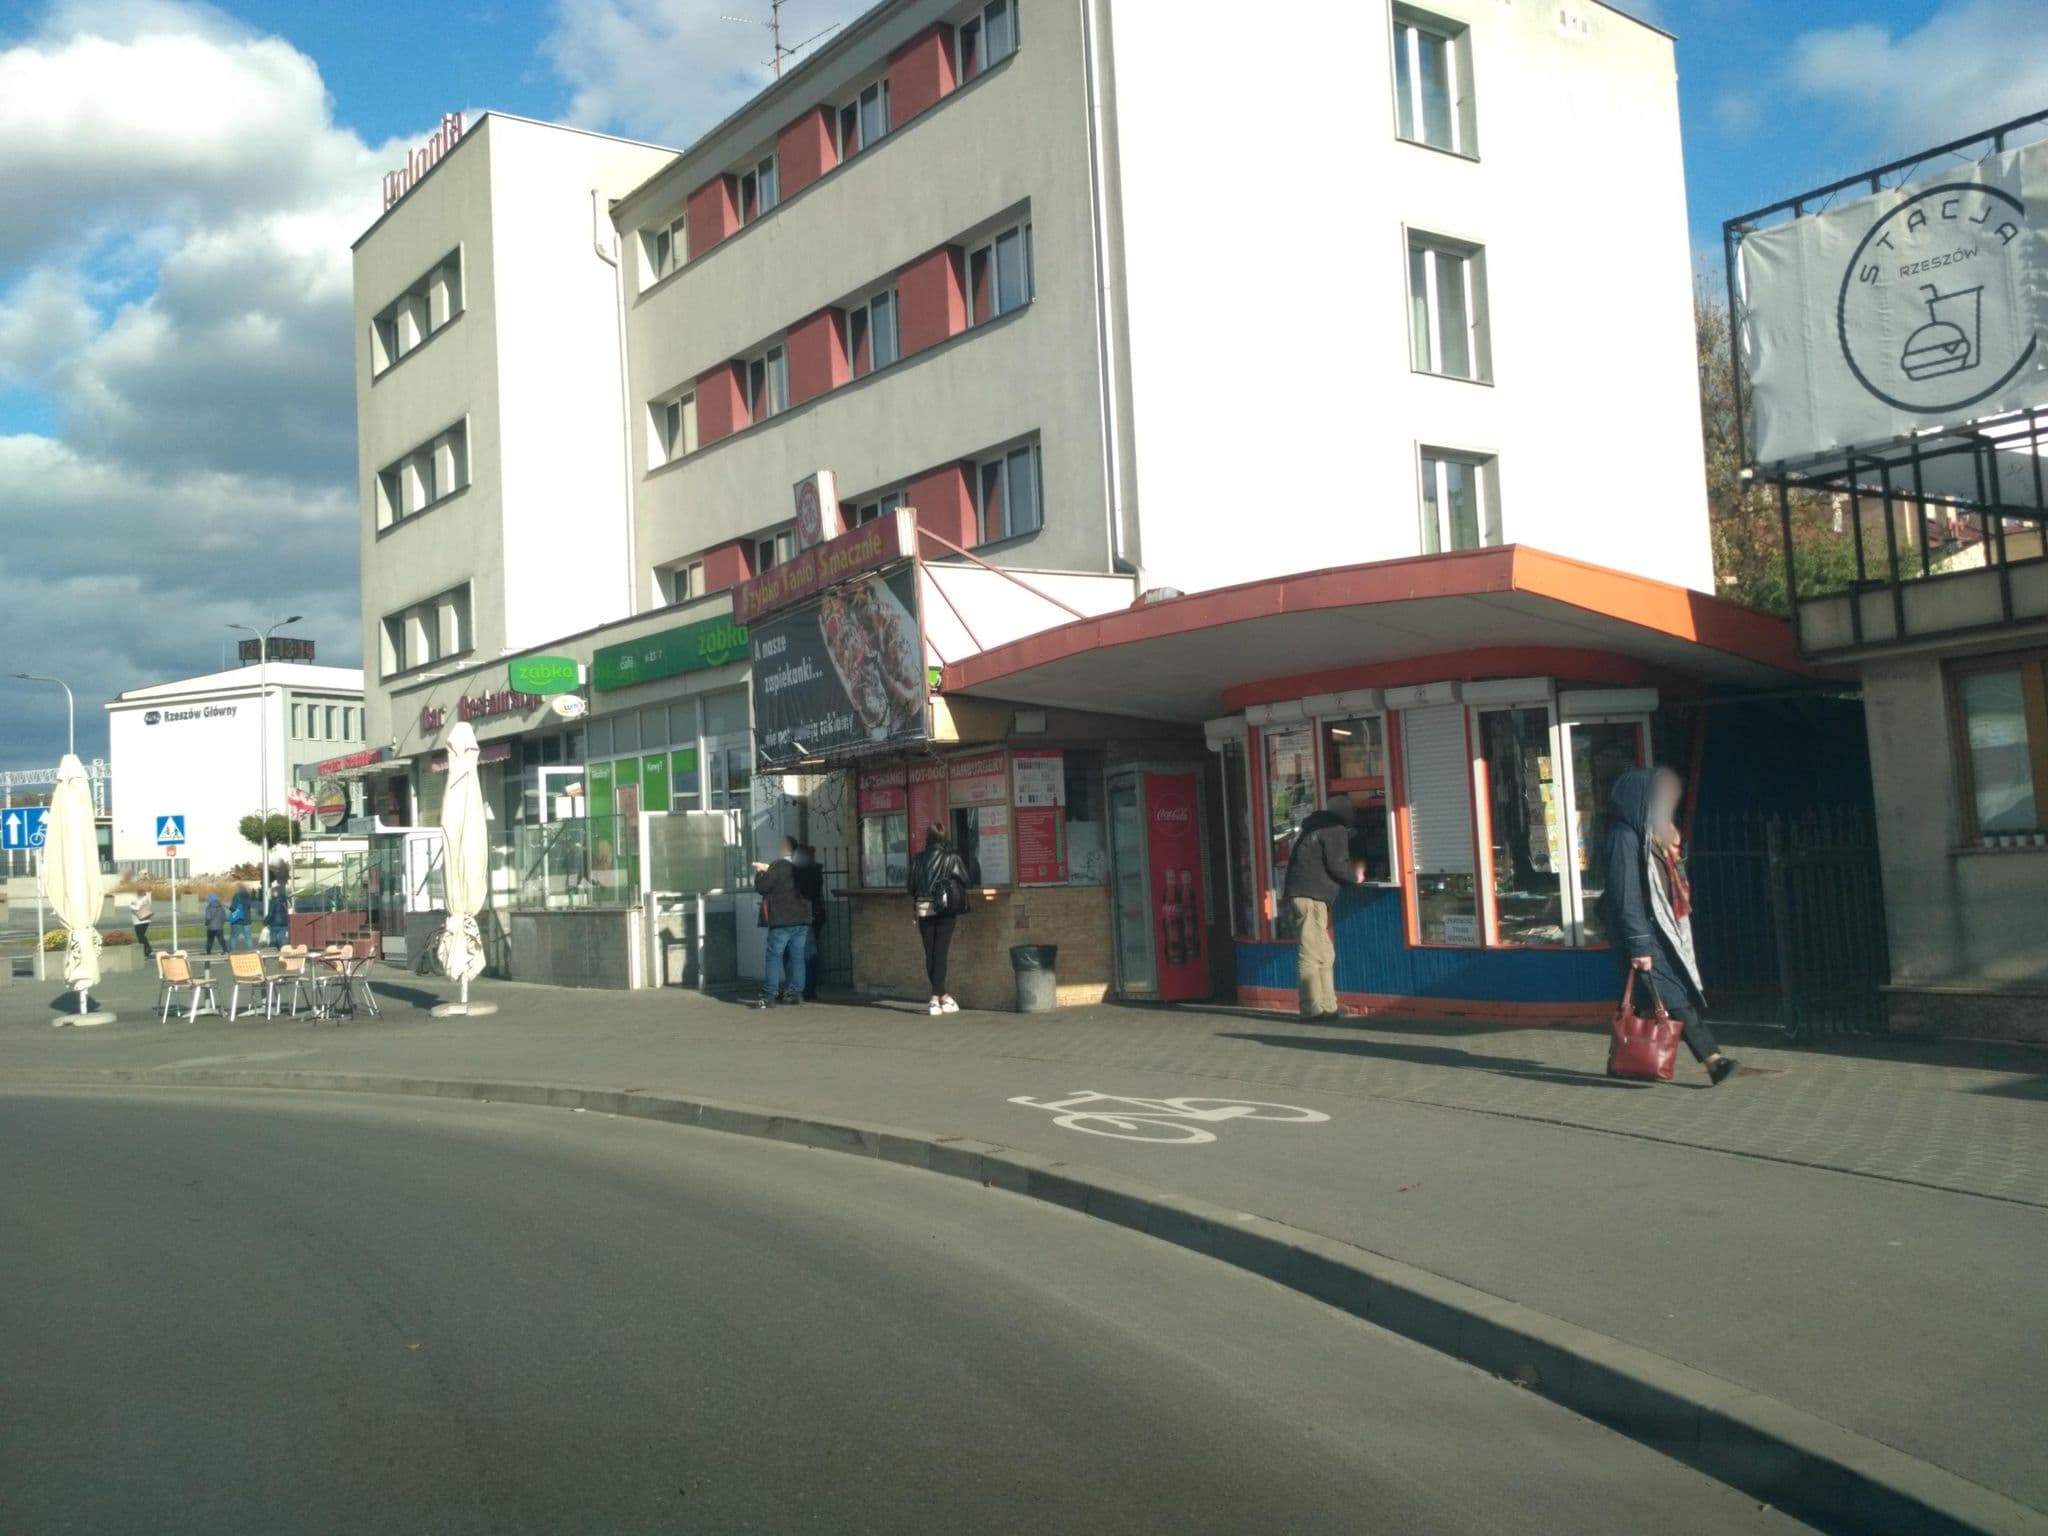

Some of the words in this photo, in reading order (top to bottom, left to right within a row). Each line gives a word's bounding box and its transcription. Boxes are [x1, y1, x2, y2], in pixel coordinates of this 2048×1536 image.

[1859, 199, 2019, 285] STACJA
[1899, 246, 1979, 278] RZESZÓW
[818, 529, 882, 577] Smacznie
[762, 636, 786, 659] nasze
[163, 707, 201, 722] Rzeszów
[203, 705, 238, 719] Główny
